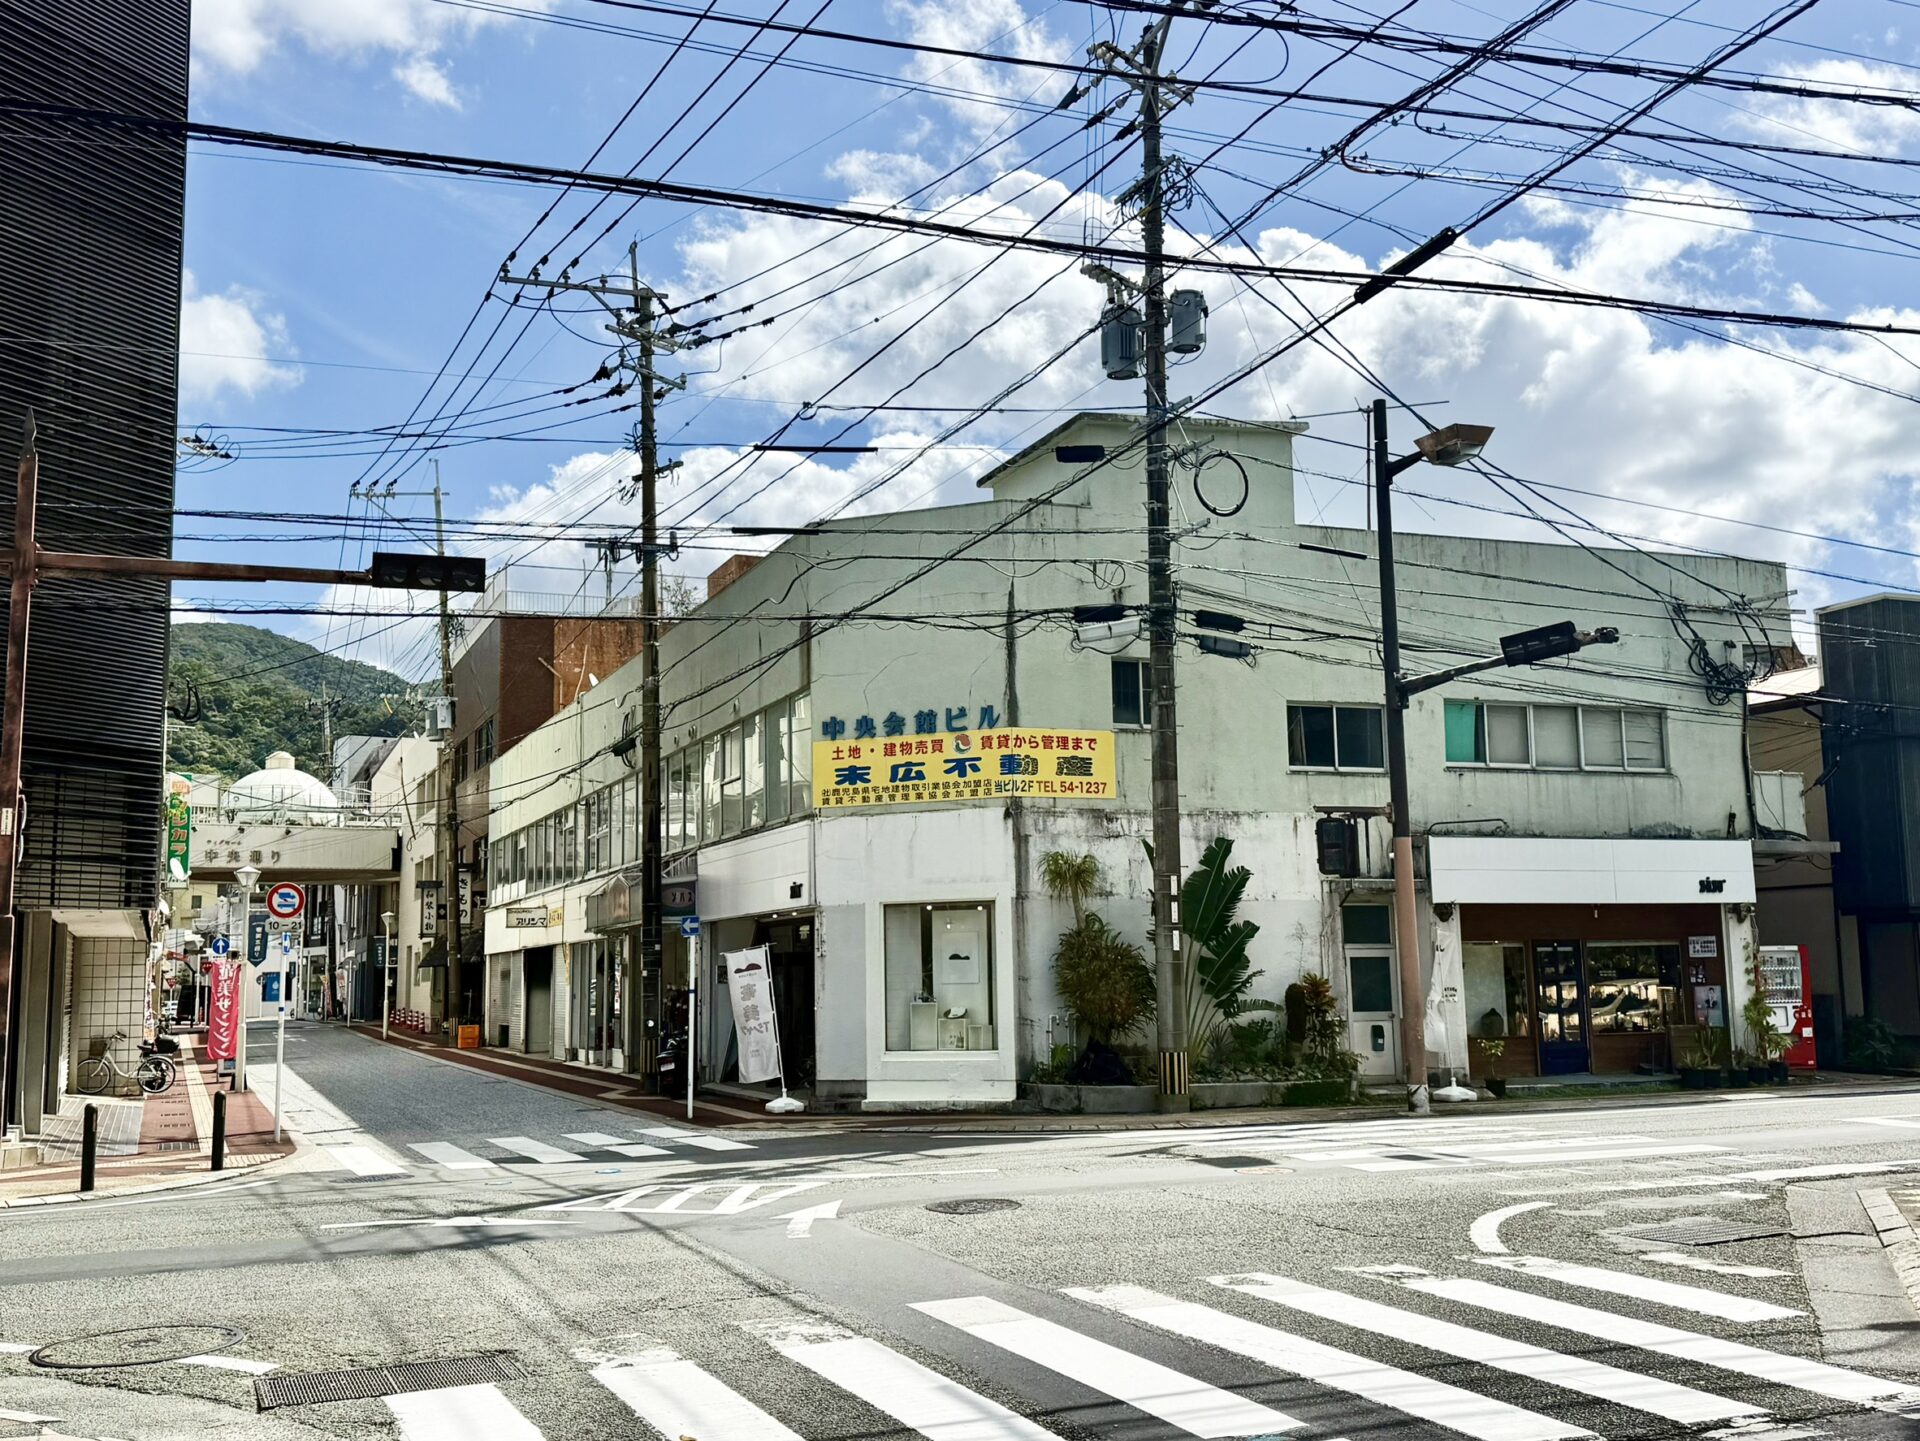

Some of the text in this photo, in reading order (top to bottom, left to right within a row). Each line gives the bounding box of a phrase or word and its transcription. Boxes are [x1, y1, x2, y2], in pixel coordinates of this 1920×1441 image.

[821, 705, 1001, 741] 中央会館ビル
[831, 739, 944, 761] 土地・建物売買
[980, 734, 1098, 751] 賃貸から管理まで
[833, 753, 1094, 785] 末広不動産
[994, 780, 1107, 794] 当ビル2F TEL 54-1237
[821, 788, 992, 805] 賃貸不動産管理業協会加盟店
[204, 848, 281, 864] 中央通り
